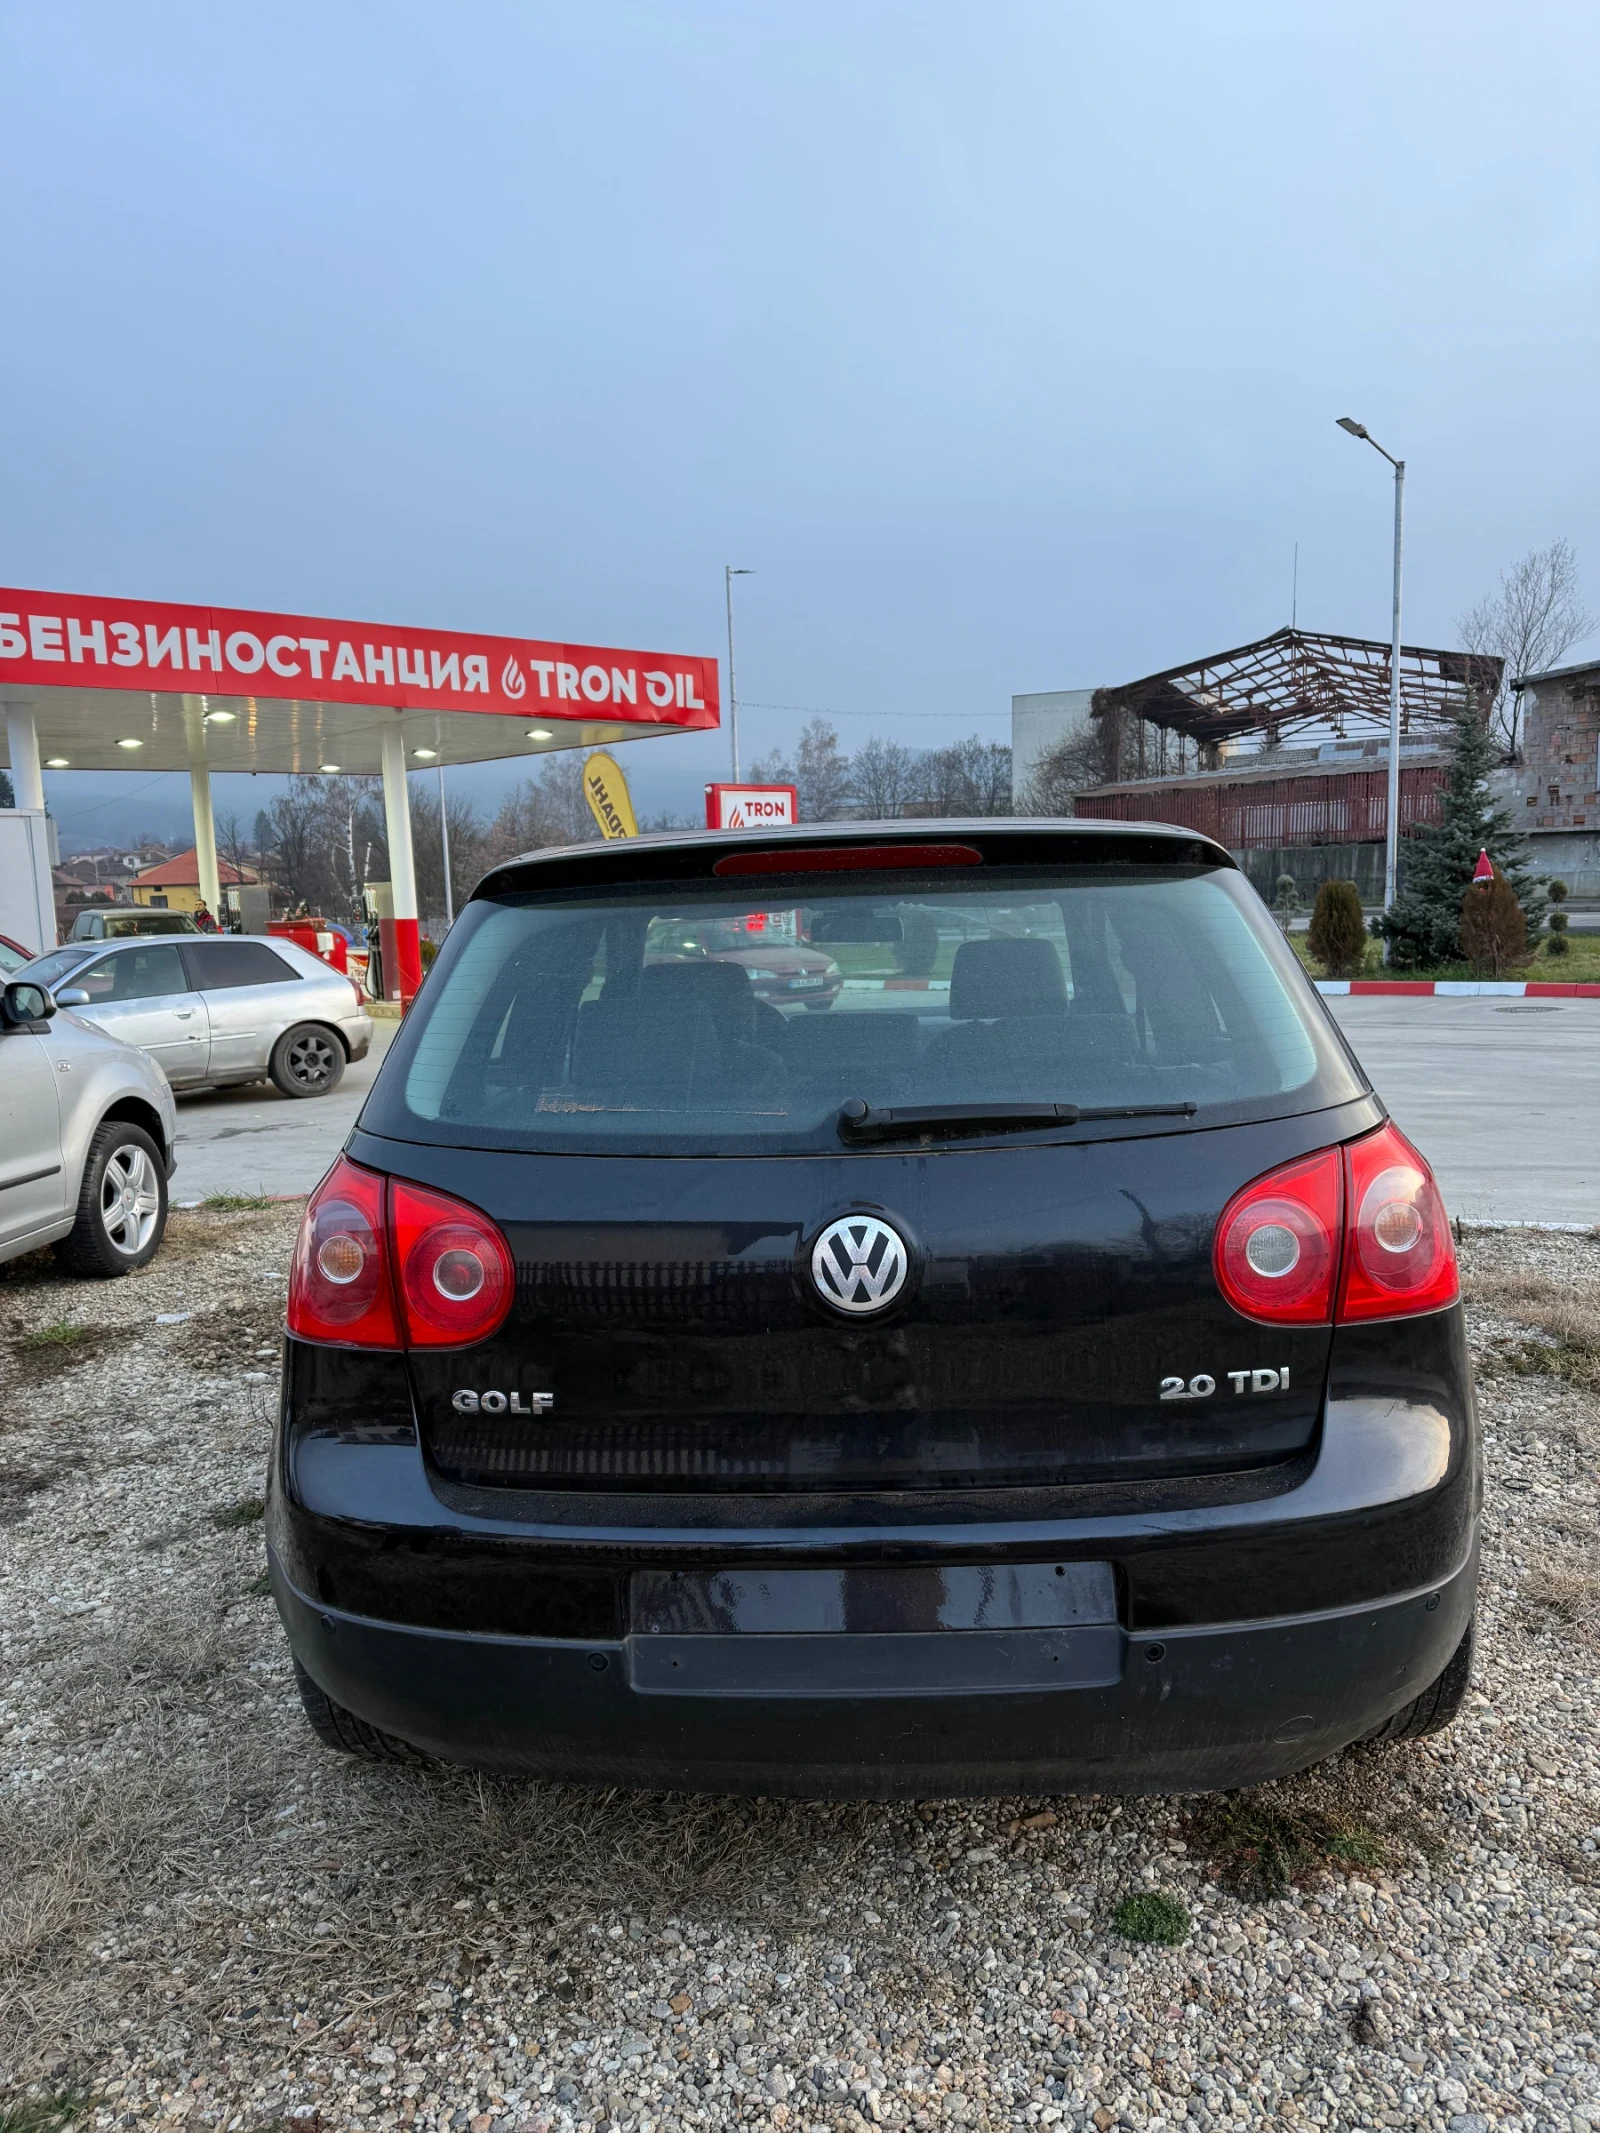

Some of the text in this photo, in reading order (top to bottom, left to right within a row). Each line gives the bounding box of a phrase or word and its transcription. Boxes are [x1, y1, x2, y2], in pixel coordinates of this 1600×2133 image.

[0, 612, 490, 693] БЕНЗИНОСТАНЦИЯ
[531, 660, 705, 709] TRON OIL
[744, 802, 785, 817] TRON
[1227, 1366, 1290, 1394] TDI
[451, 1389, 554, 1415] GOLF
